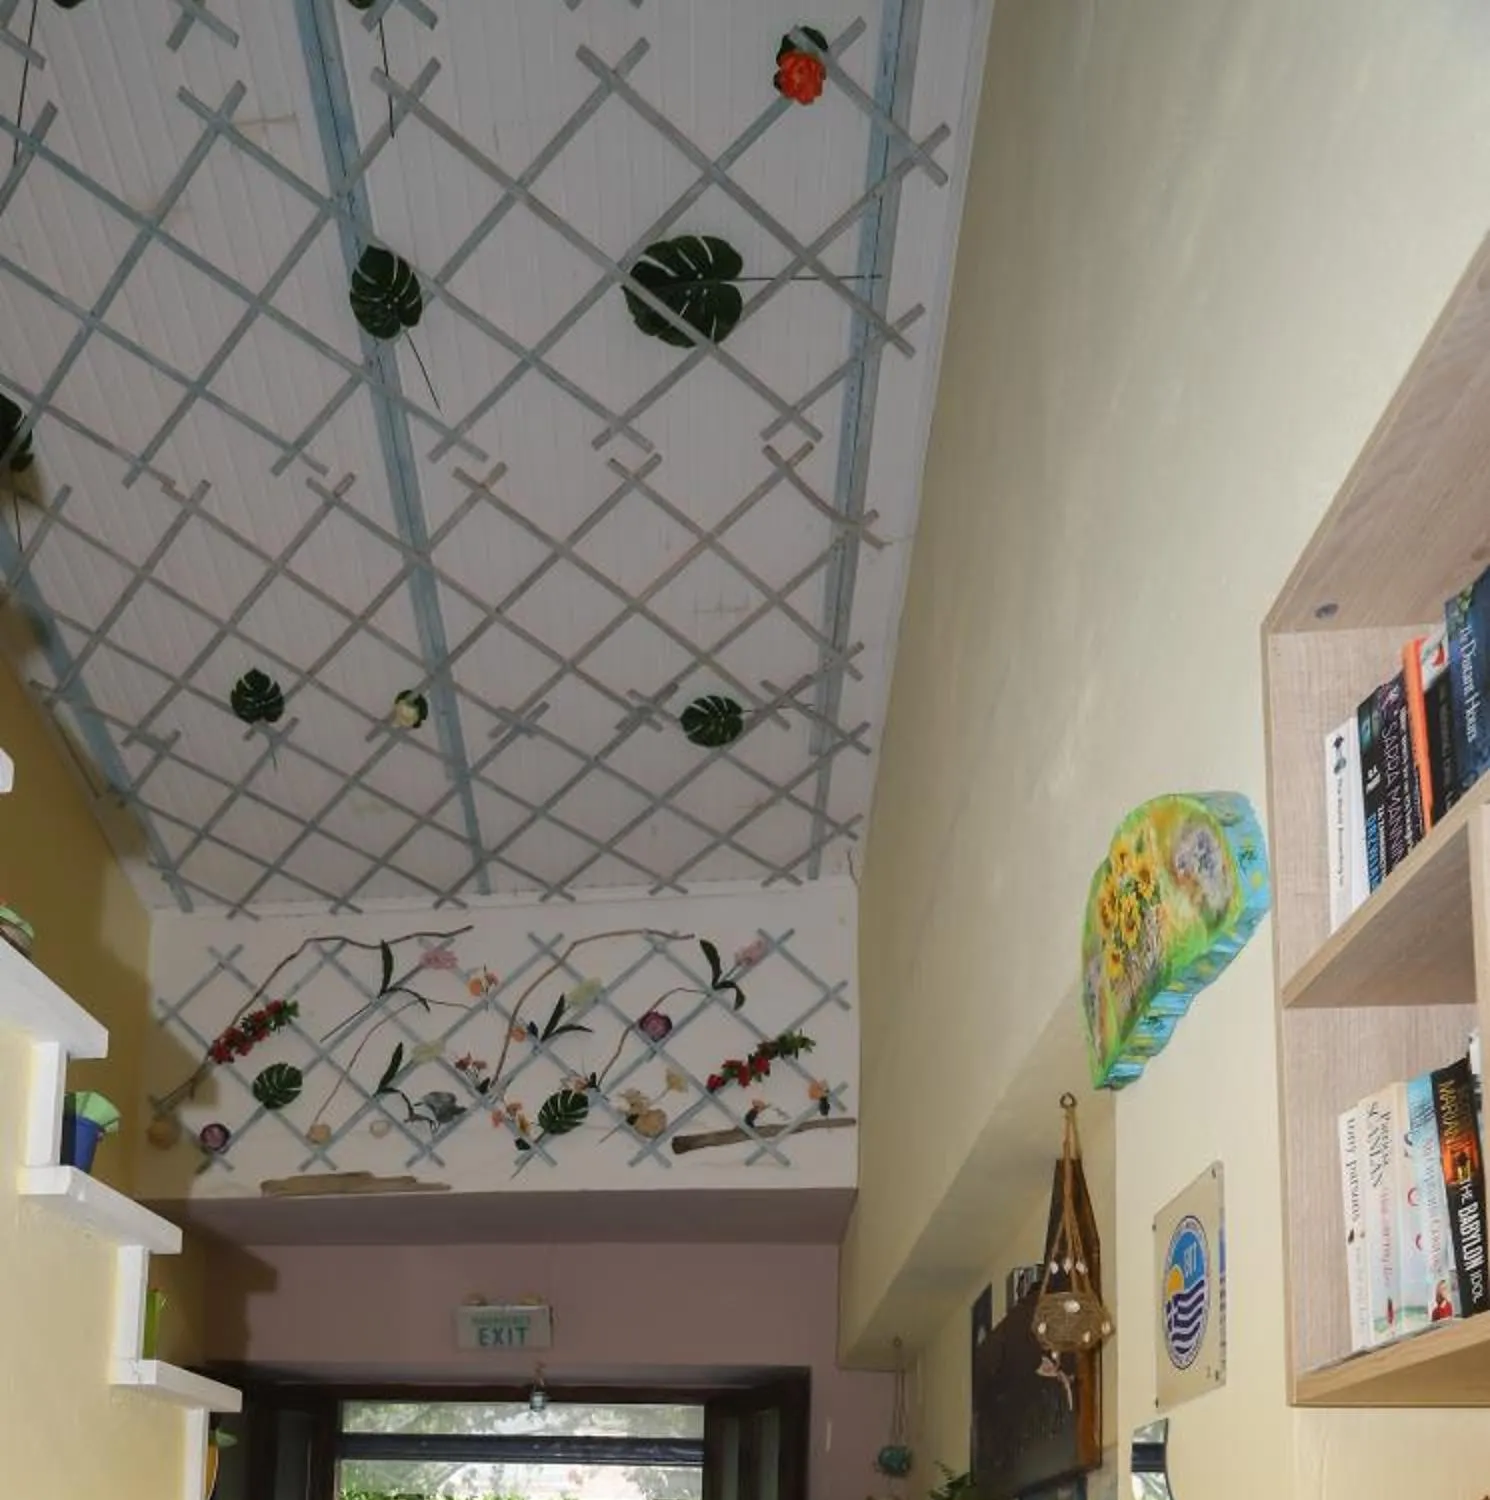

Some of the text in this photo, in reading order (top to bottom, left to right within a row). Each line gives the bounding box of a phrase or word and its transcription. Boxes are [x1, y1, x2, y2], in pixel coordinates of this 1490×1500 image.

[1461, 638, 1477, 696] Distant
[1464, 691, 1481, 743] Hours
[1346, 1118, 1360, 1222] tony parsons
[1368, 1101, 1383, 1188] SCANLAN
[1458, 1178, 1485, 1304] THE BABYLON IDOL
[478, 1326, 529, 1347] EXIT
